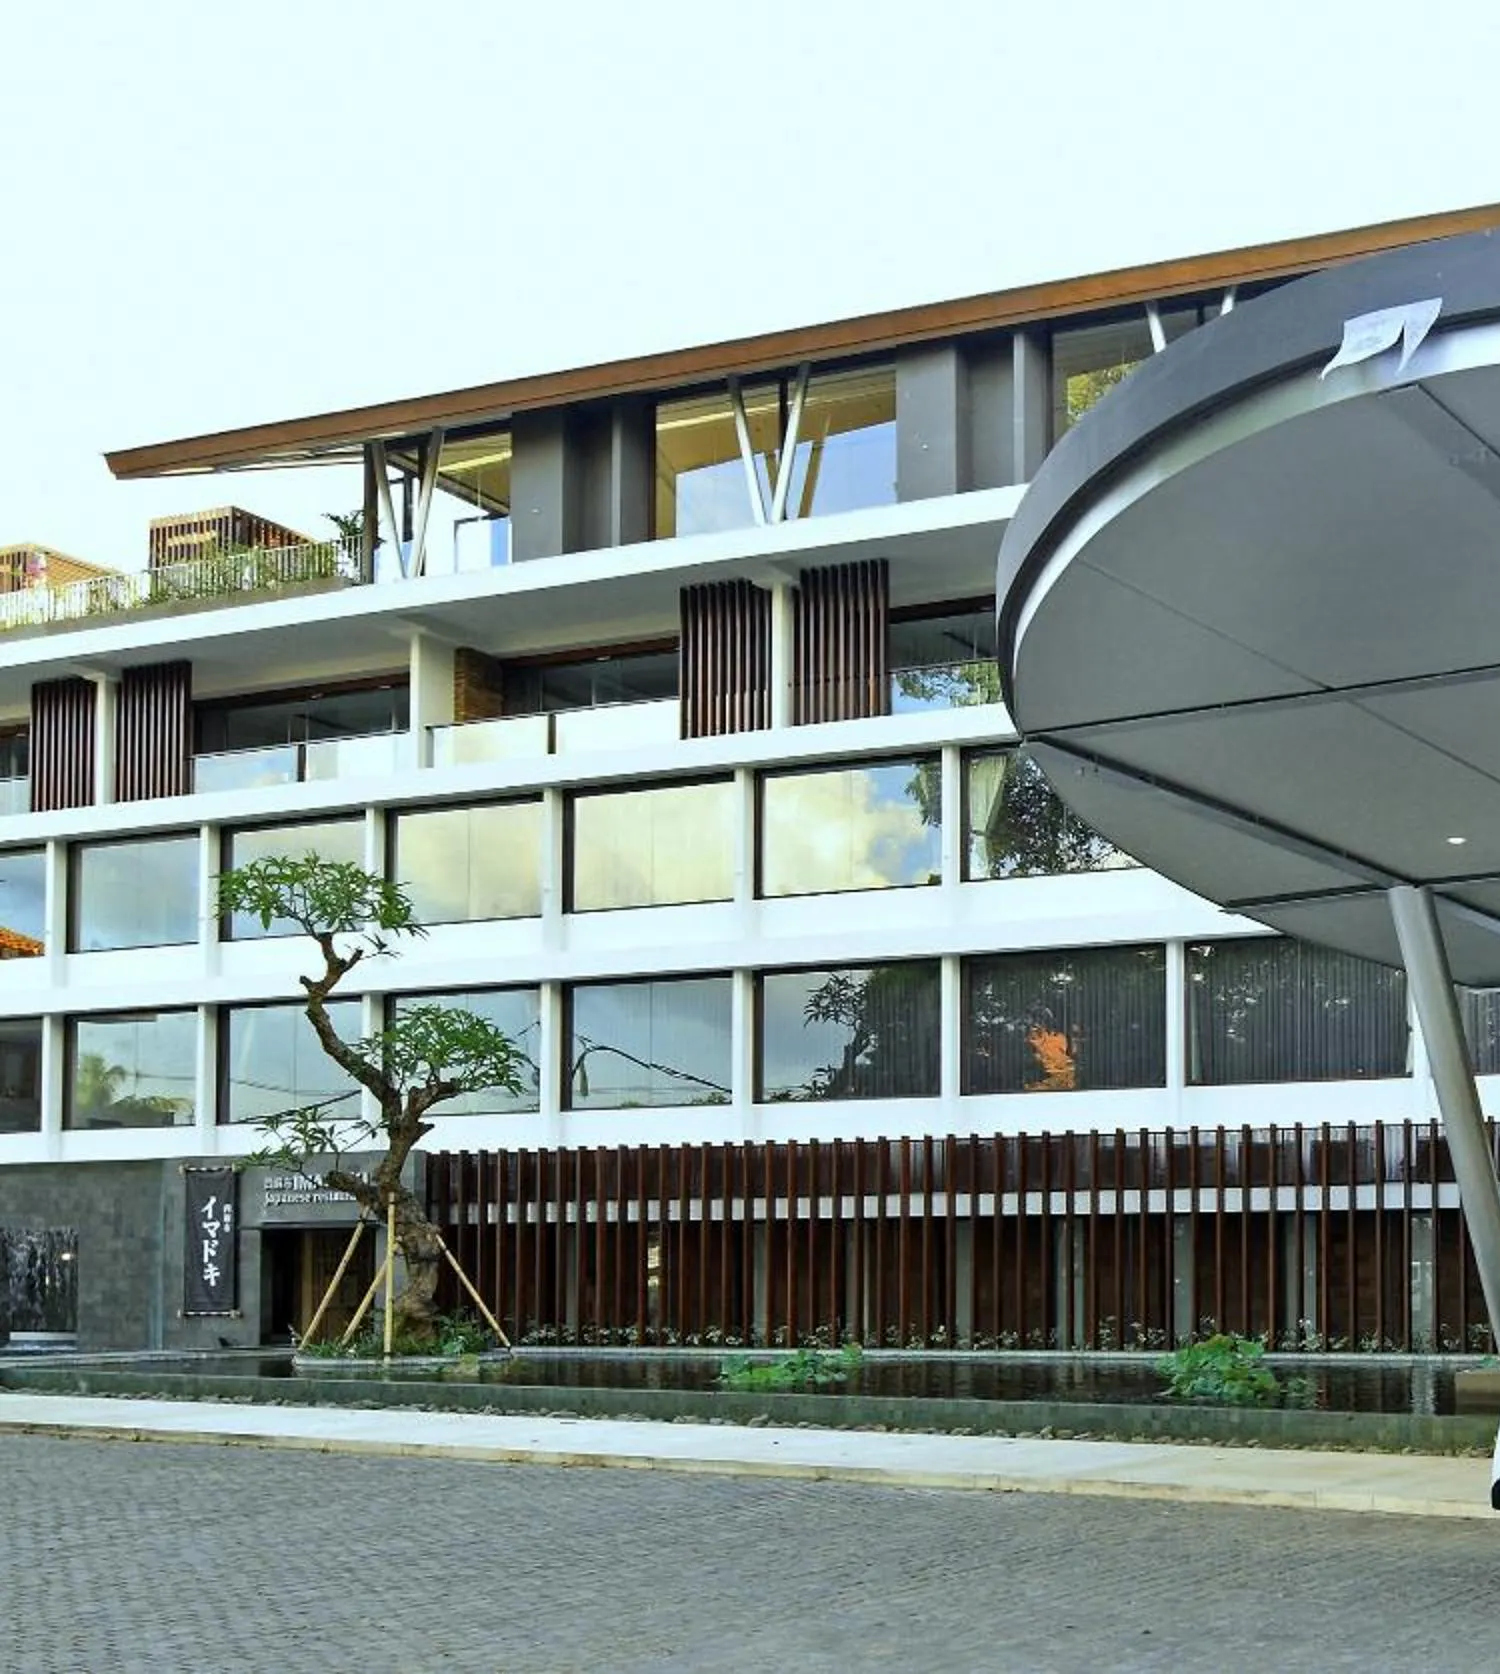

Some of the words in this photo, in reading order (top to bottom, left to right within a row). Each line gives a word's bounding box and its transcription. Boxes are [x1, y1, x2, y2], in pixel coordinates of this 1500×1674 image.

[264, 1190, 313, 1206] Japanese
[201, 1196, 221, 1287] イマドキ
